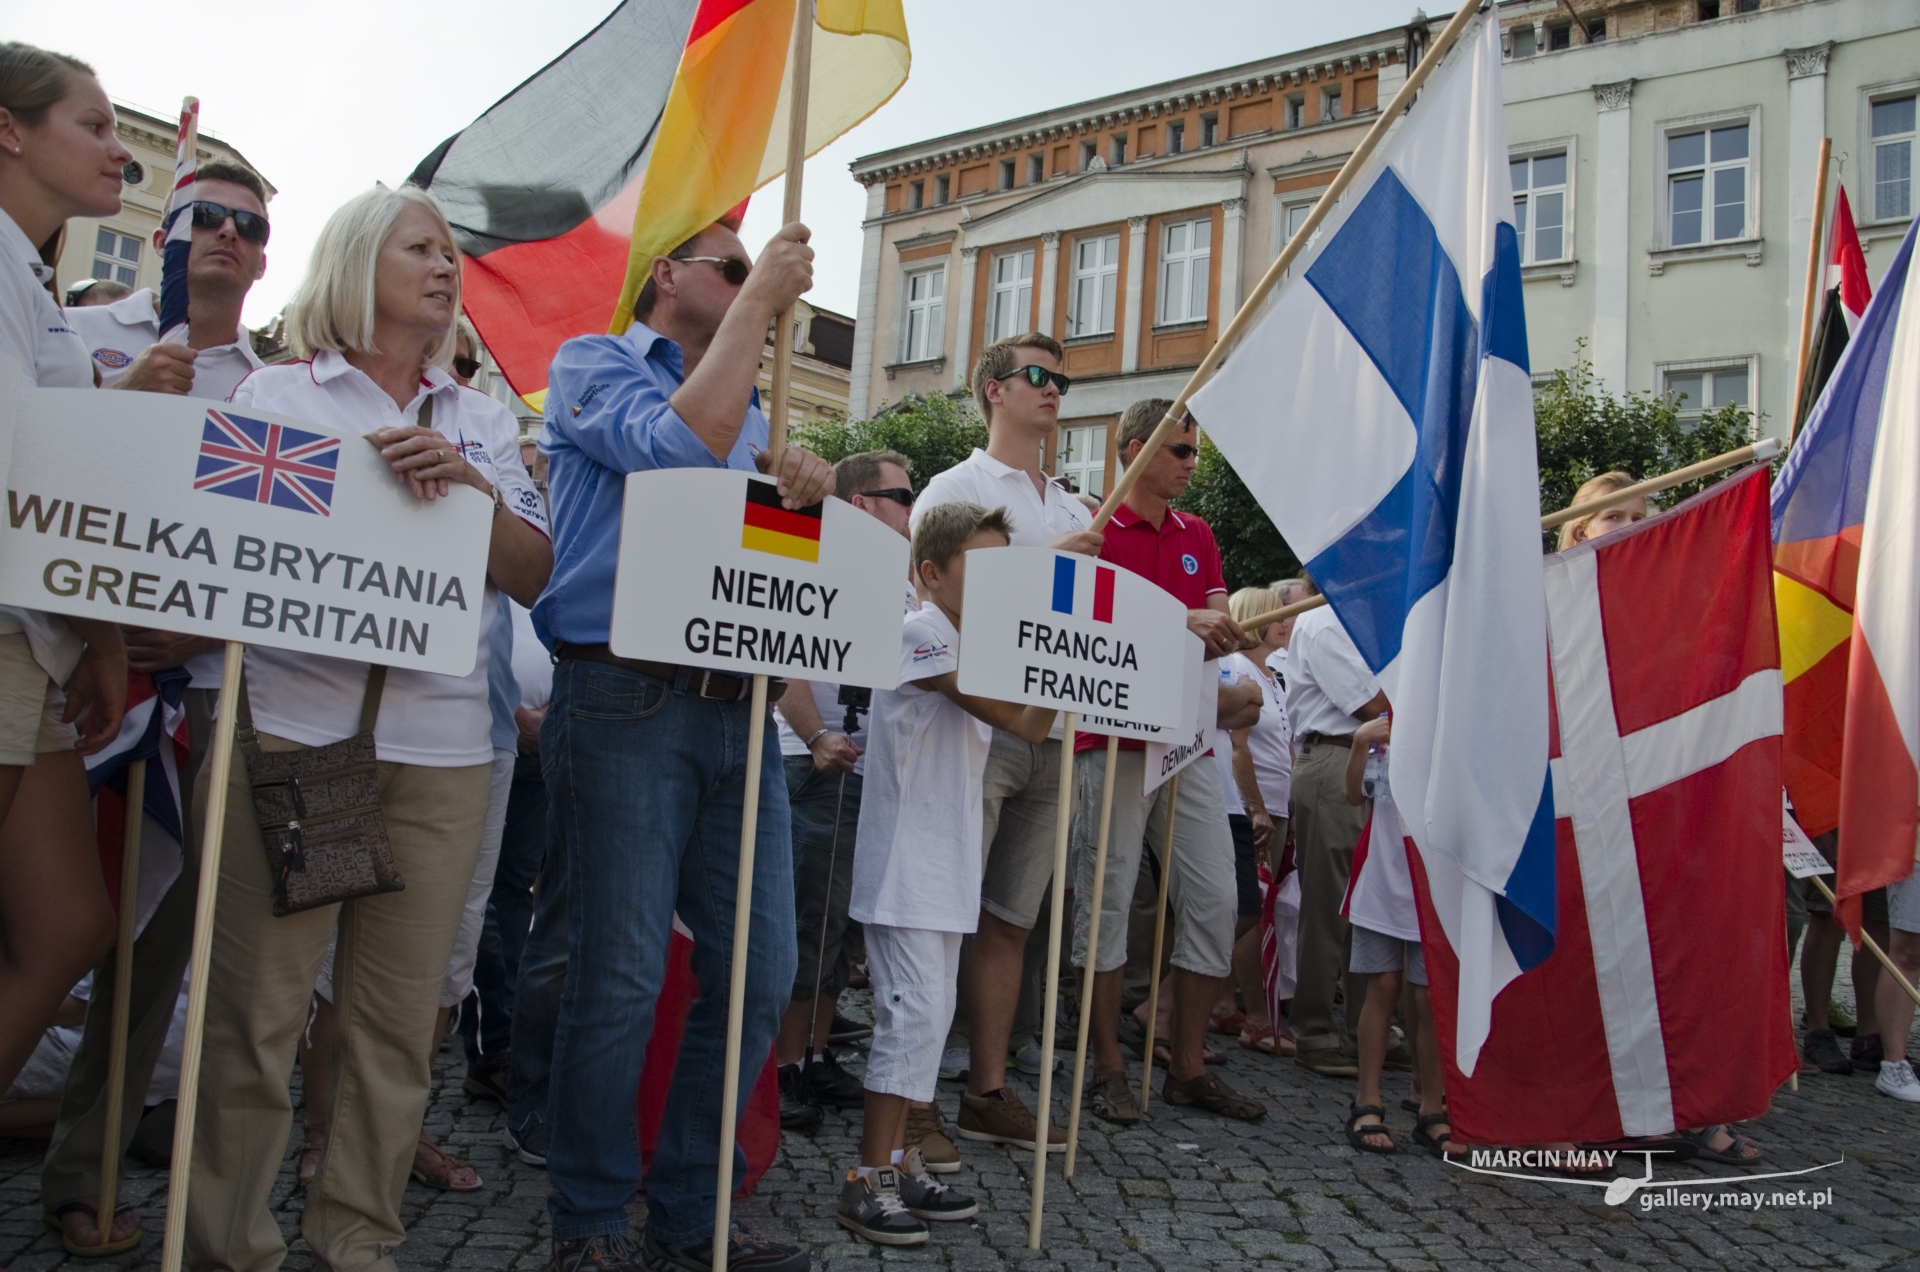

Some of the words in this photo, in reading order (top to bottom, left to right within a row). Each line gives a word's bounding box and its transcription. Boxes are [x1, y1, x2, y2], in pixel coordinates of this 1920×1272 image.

[8, 490, 217, 565] WIELKA
[233, 534, 468, 611] BRYTANIA
[42, 558, 228, 620] GREAT
[242, 591, 429, 656] BRITAIN
[711, 565, 839, 619] NIEMCY
[685, 617, 852, 672] GERMANY
[1018, 620, 1138, 671] FRANCJA
[1024, 665, 1129, 710] FRANCE
[1161, 729, 1204, 776] DENMARK
